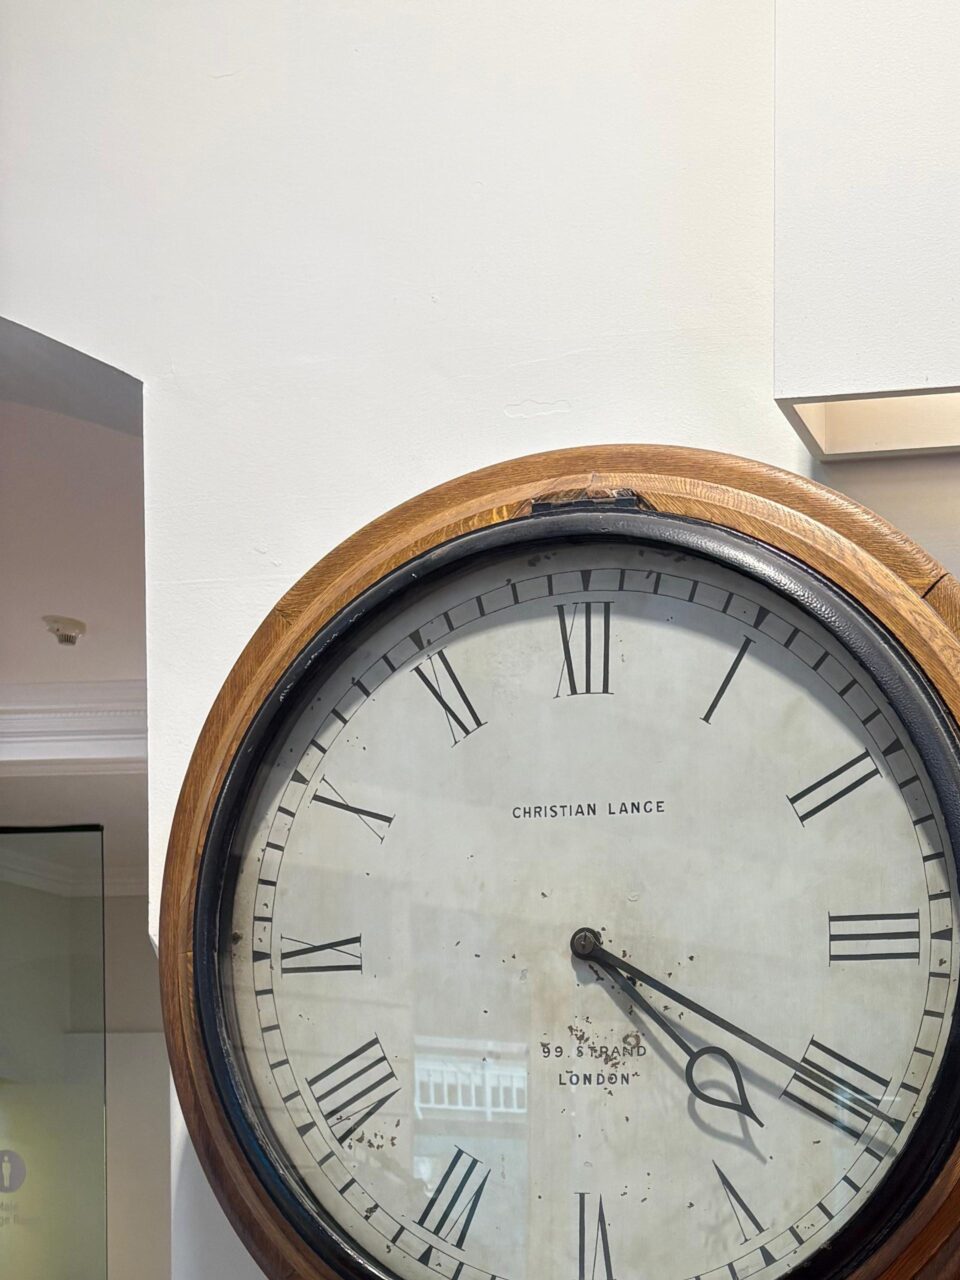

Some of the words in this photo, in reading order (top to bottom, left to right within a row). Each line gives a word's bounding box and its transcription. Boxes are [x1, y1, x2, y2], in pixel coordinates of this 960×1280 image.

[553, 600, 615, 698] XII
[410, 647, 488, 747] XI
[310, 776, 396, 843] X
[512, 802, 597, 819] CHRISTIAN
[607, 800, 666, 816] LANCE
[786, 747, 883, 827] II
[280, 933, 362, 974] IX
[828, 911, 920, 966] III
[558, 1071, 631, 1086] LONDON
[576, 1044, 647, 1058] STRAND
